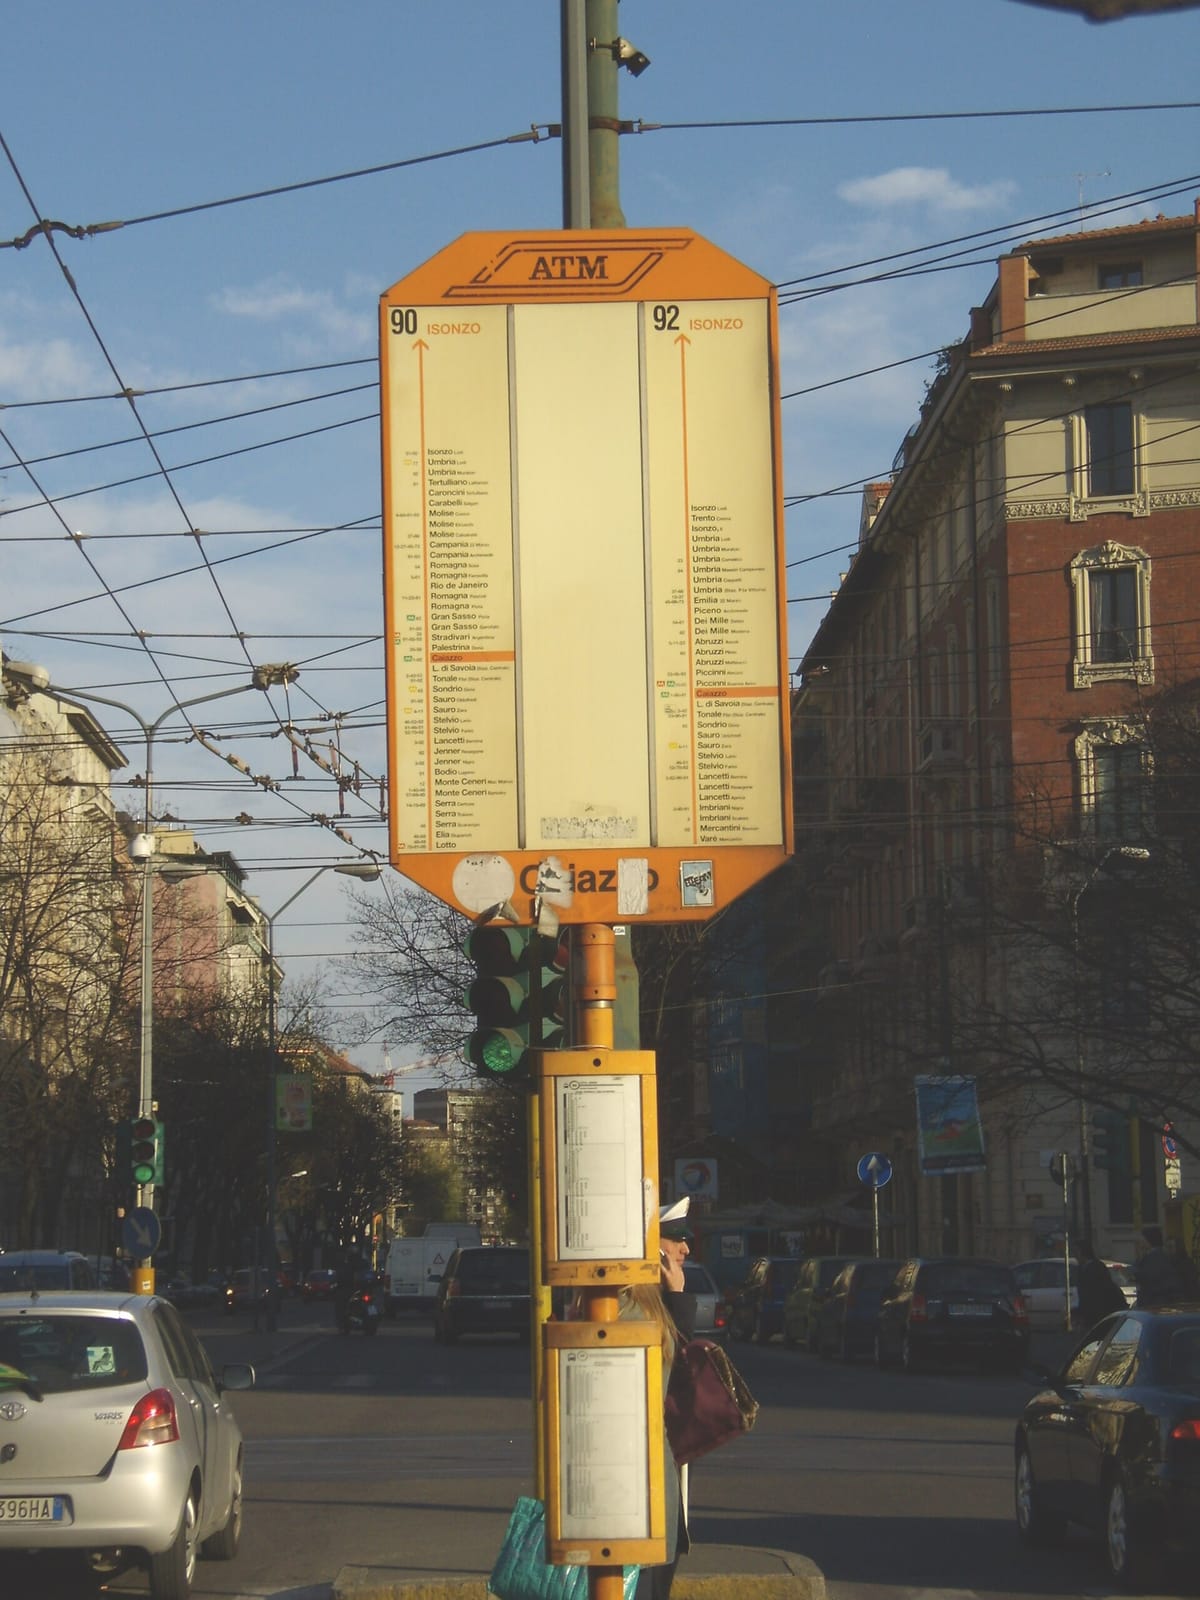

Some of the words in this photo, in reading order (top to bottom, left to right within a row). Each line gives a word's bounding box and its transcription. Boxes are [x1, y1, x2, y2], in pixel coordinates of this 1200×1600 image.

[528, 256, 609, 280] ATM
[391, 309, 418, 335] 90
[427, 323, 481, 335] ISONZO
[653, 305, 680, 331] 92
[689, 319, 743, 330] ISONZO
[430, 541, 469, 549] Campania
[431, 572, 467, 580] Romagna
[519, 864, 659, 895] Ciazo
[0, 1499, 50, 1518] 396HA
